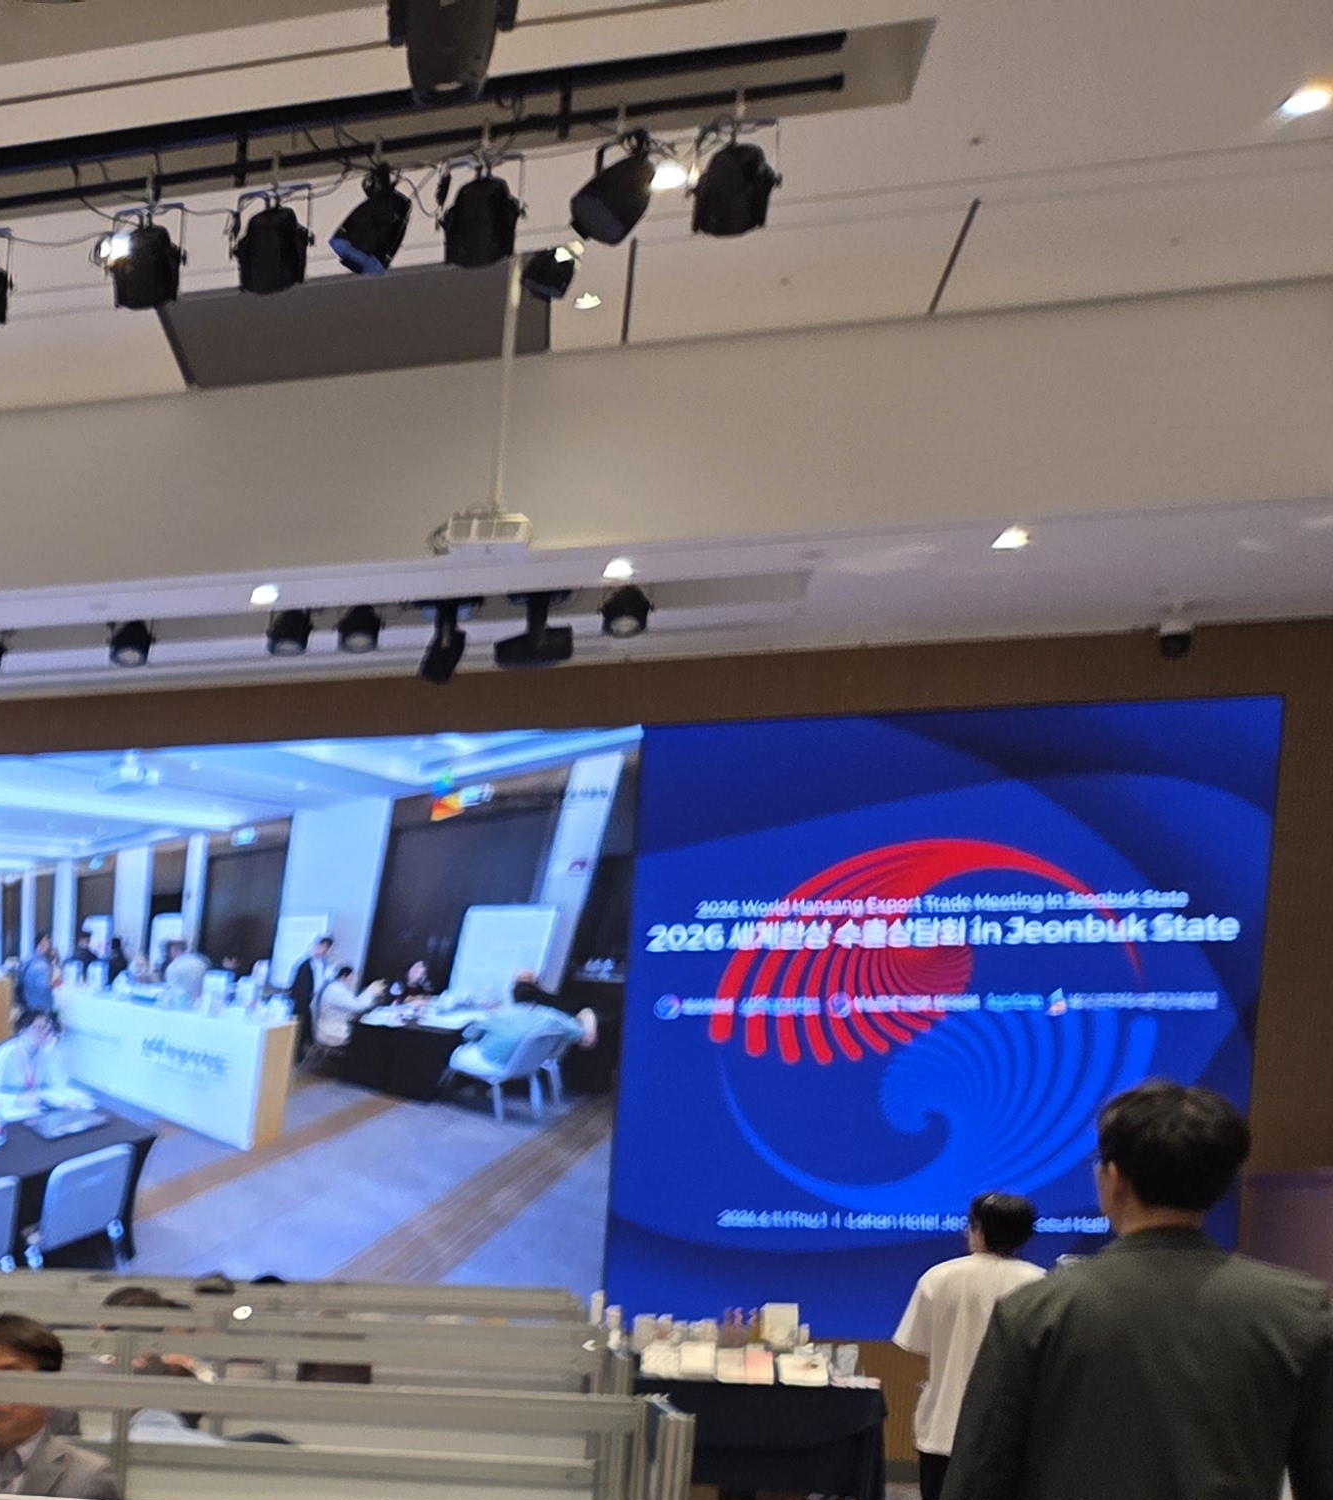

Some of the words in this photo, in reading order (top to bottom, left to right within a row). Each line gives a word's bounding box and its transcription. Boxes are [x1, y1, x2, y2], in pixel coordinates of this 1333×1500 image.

[740, 898, 789, 917] World
[792, 898, 863, 917] Hansang
[865, 895, 921, 915] Export
[922, 893, 972, 913] Trade
[974, 891, 1044, 914] Meeting
[1064, 889, 1140, 910] Jeonbuk
[1141, 889, 1189, 909] State
[645, 923, 725, 952] 2026
[834, 916, 966, 949] 수출상담회
[1003, 913, 1147, 944] Jeonbuk
[1148, 912, 1240, 942] State
